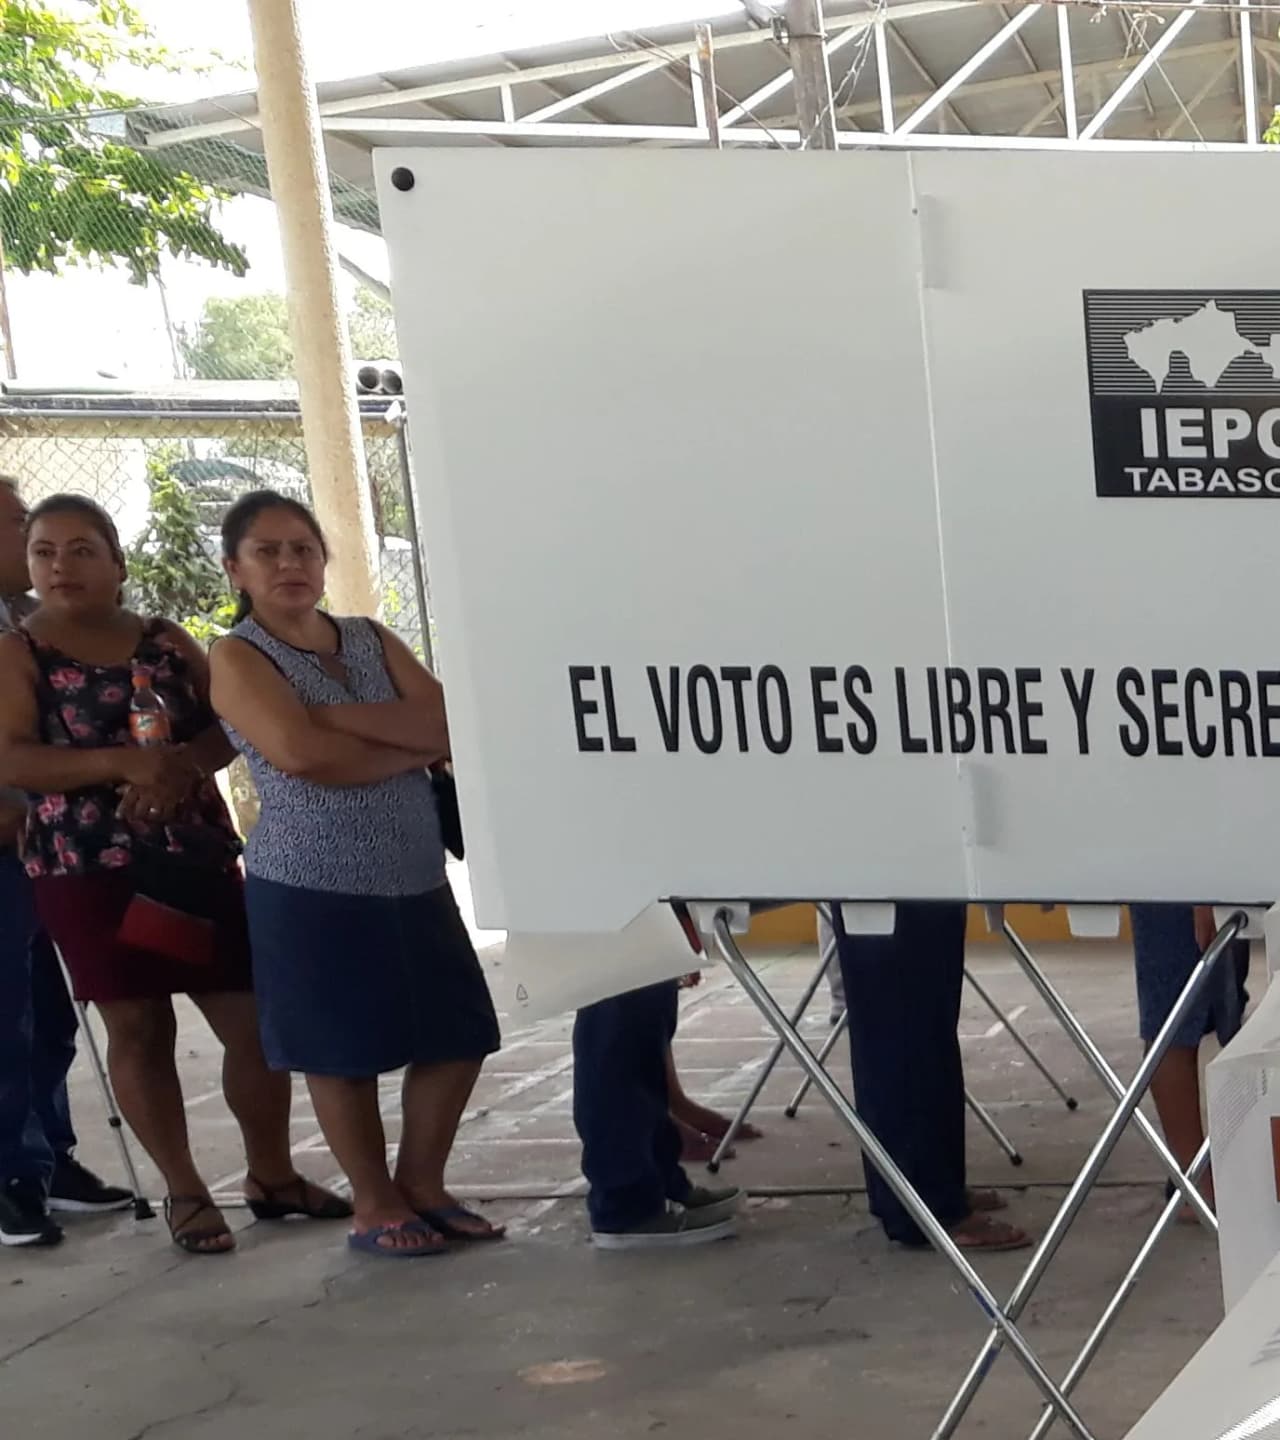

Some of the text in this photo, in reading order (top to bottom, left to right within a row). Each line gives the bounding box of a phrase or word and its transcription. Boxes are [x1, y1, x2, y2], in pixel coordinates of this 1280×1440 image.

[568, 664, 637, 754] EL
[646, 663, 793, 756] VOTO
[810, 665, 877, 754] ES
[896, 666, 1049, 755] LIBRE
[1059, 667, 1097, 755] Y
